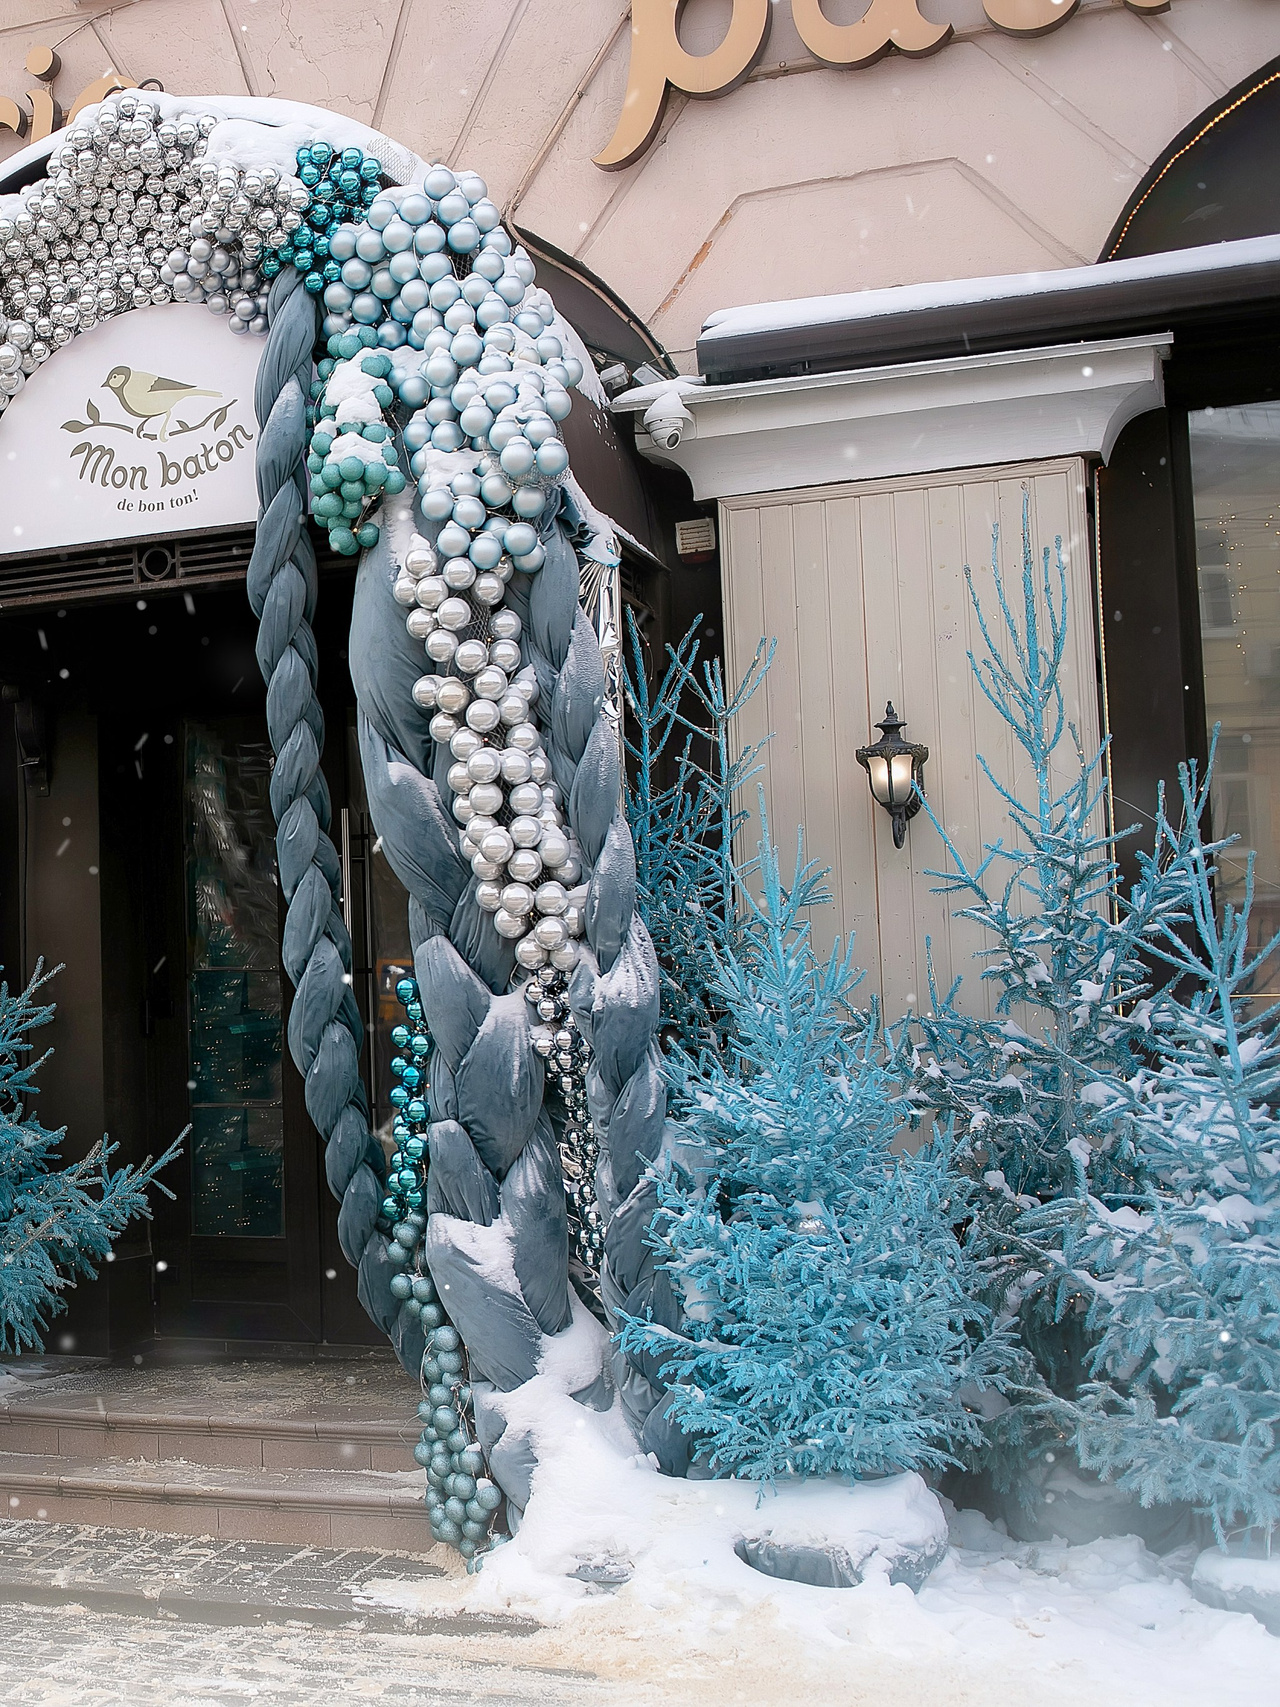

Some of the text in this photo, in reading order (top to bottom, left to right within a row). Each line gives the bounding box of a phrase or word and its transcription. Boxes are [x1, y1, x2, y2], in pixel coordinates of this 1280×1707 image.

[70, 424, 254, 491] Mon baton
[117, 488, 200, 513] de bon ton!
